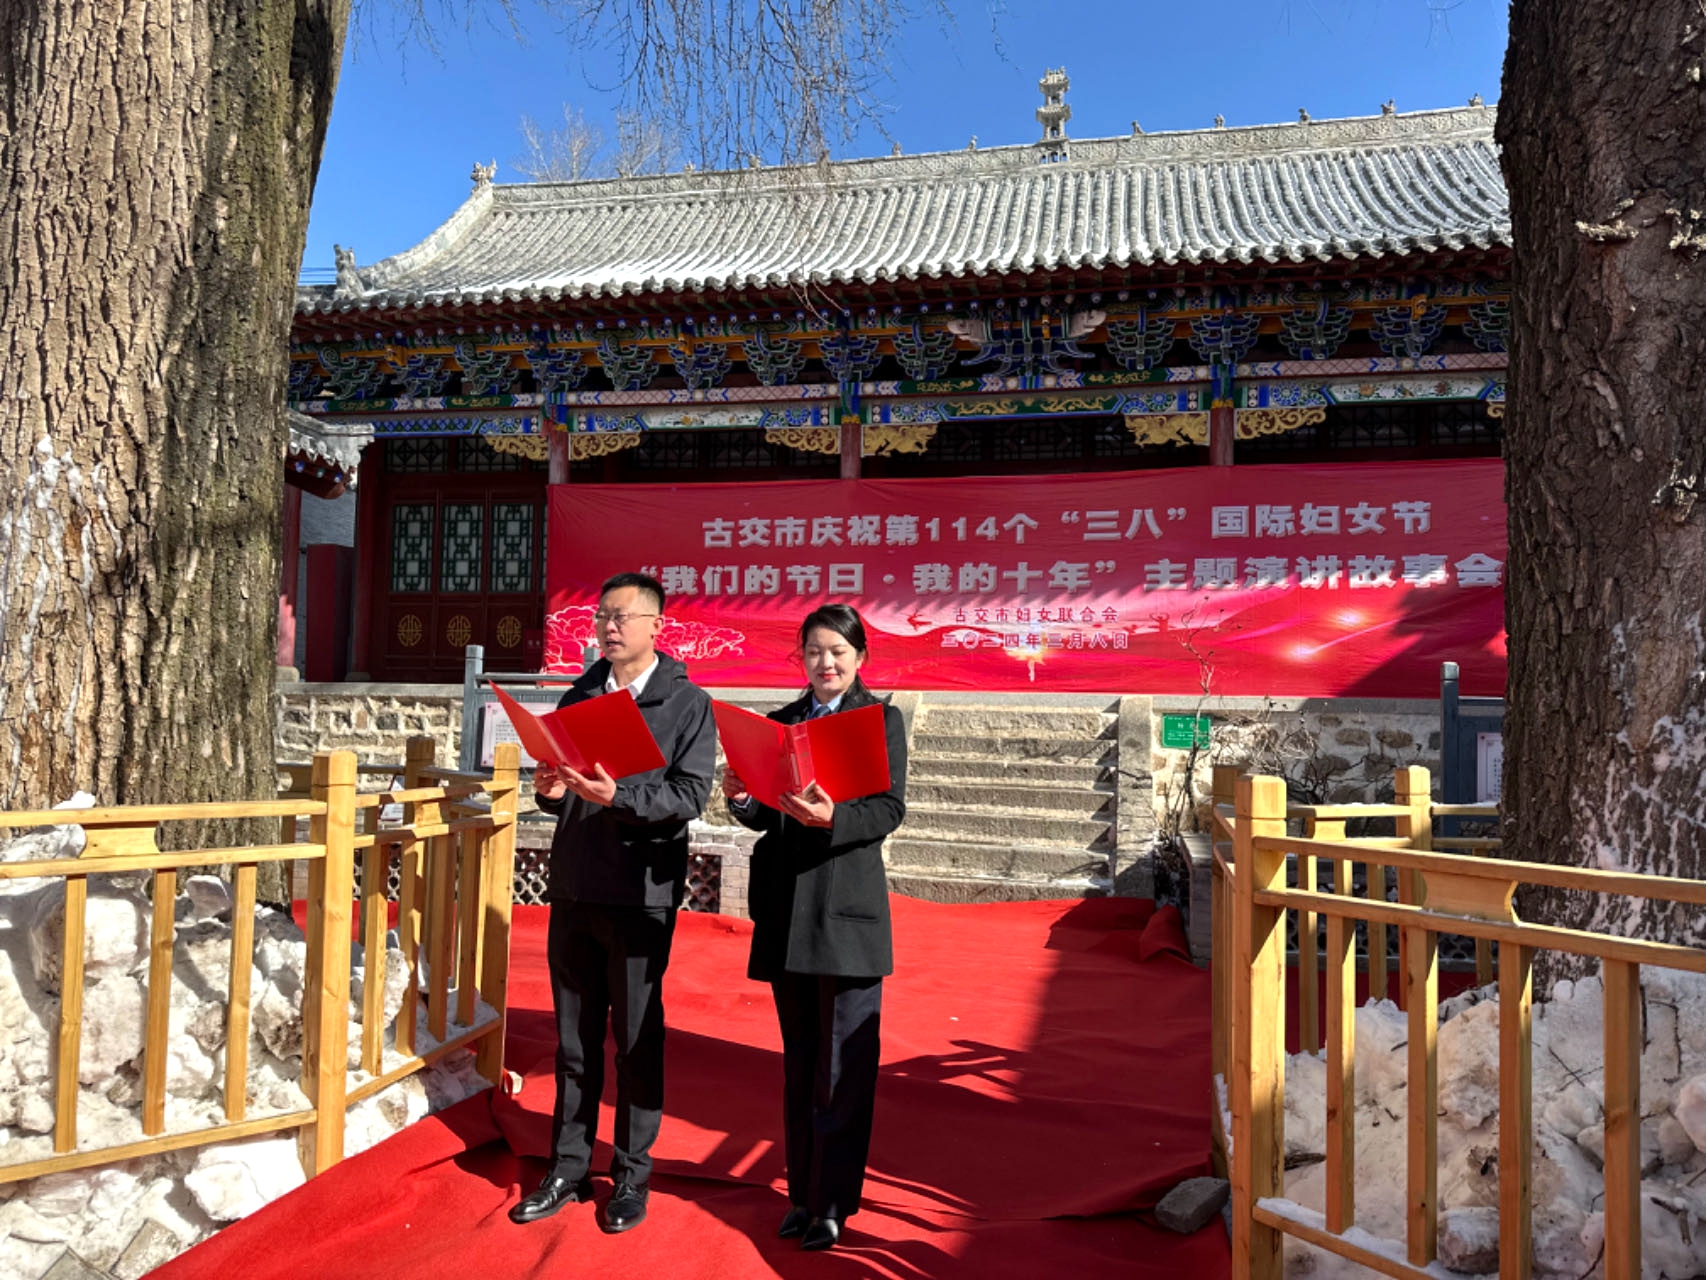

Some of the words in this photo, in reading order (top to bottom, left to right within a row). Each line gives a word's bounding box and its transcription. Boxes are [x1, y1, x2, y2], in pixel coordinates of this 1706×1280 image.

[953, 606, 1118, 623] 古交市妇女联合会
